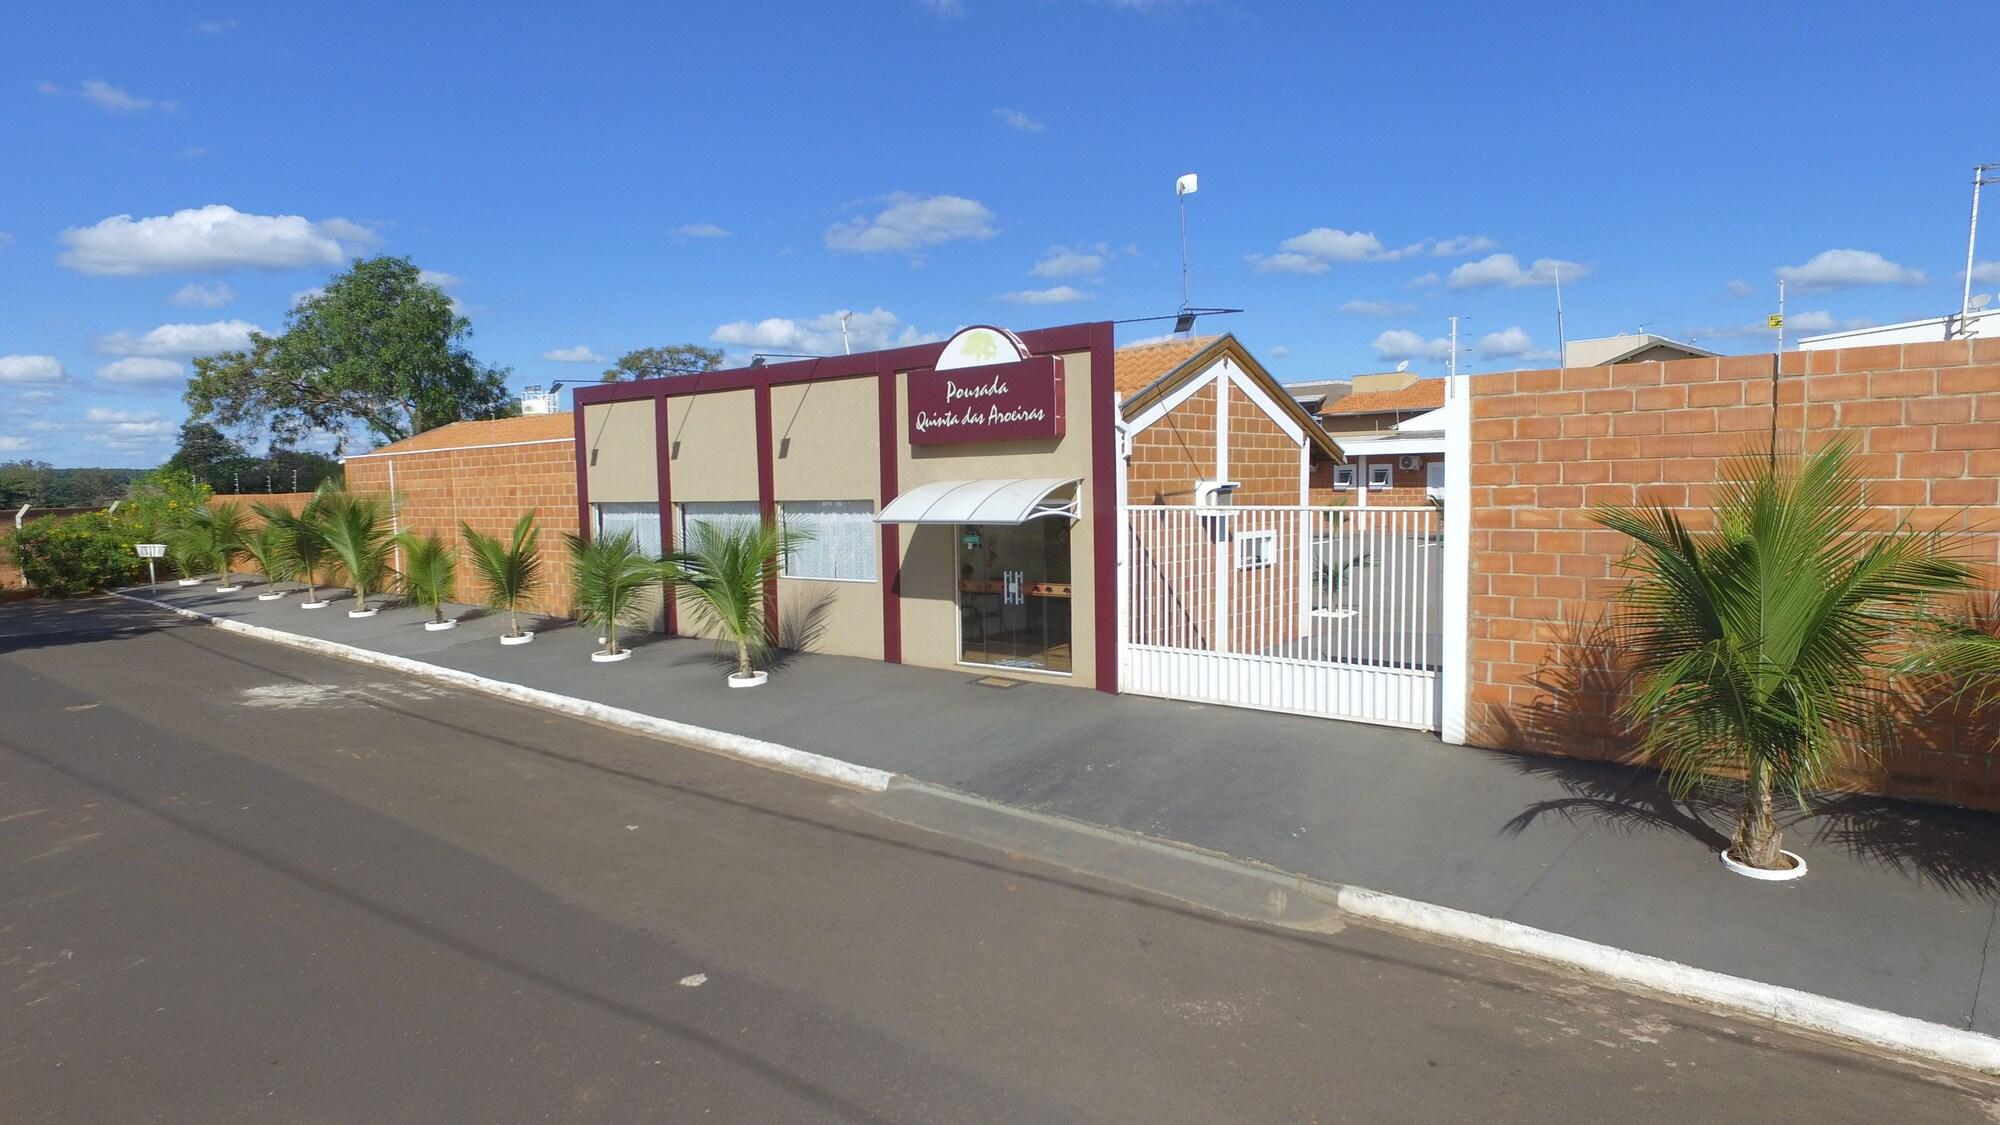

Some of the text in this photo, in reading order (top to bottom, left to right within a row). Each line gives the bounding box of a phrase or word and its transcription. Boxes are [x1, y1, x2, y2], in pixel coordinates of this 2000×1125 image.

[946, 375, 1008, 404] Pousada
[916, 404, 1045, 432] Quinta das Aroeiras
